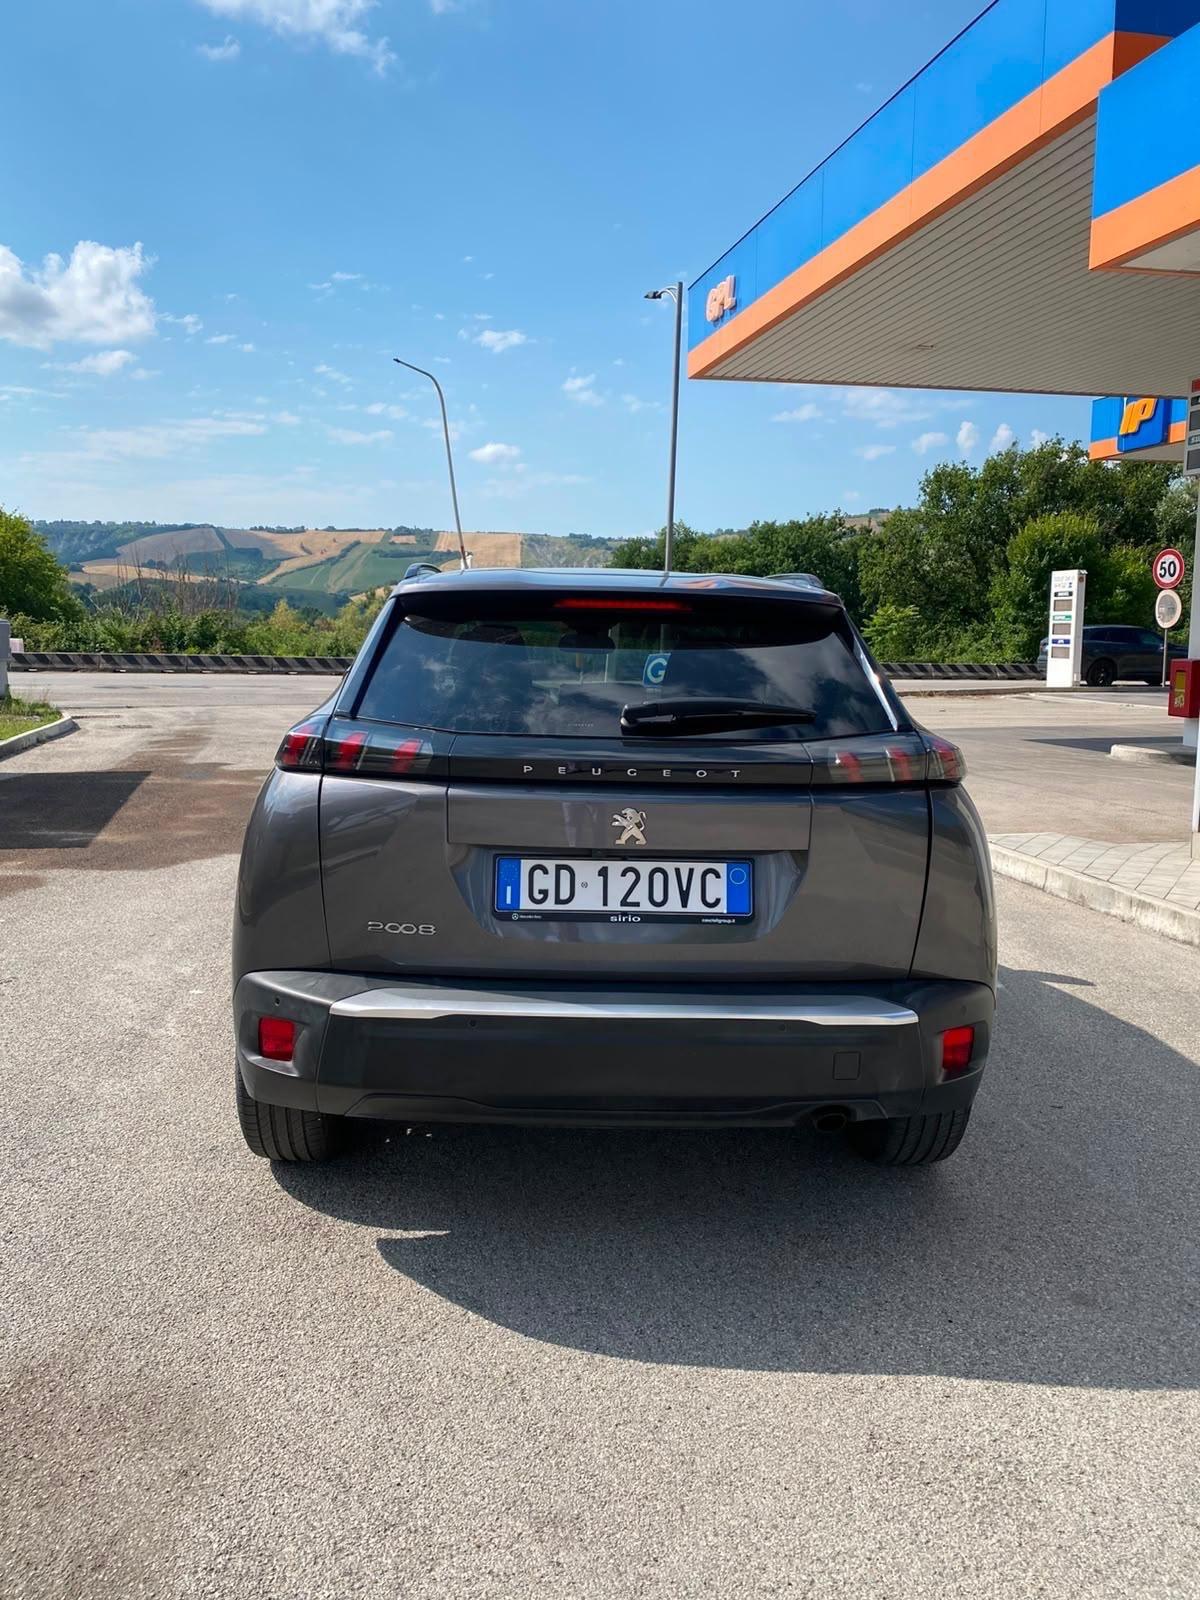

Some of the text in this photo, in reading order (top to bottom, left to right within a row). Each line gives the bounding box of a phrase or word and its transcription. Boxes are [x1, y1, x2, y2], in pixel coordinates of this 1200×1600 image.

[706, 275, 736, 322] GPL
[1159, 561, 1177, 578] 50
[647, 658, 667, 683] G
[523, 765, 741, 779] PEUGEOT
[528, 864, 576, 905] GD
[597, 866, 722, 909] 120VC
[610, 914, 641, 923] sirio
[367, 921, 437, 935] 2008
